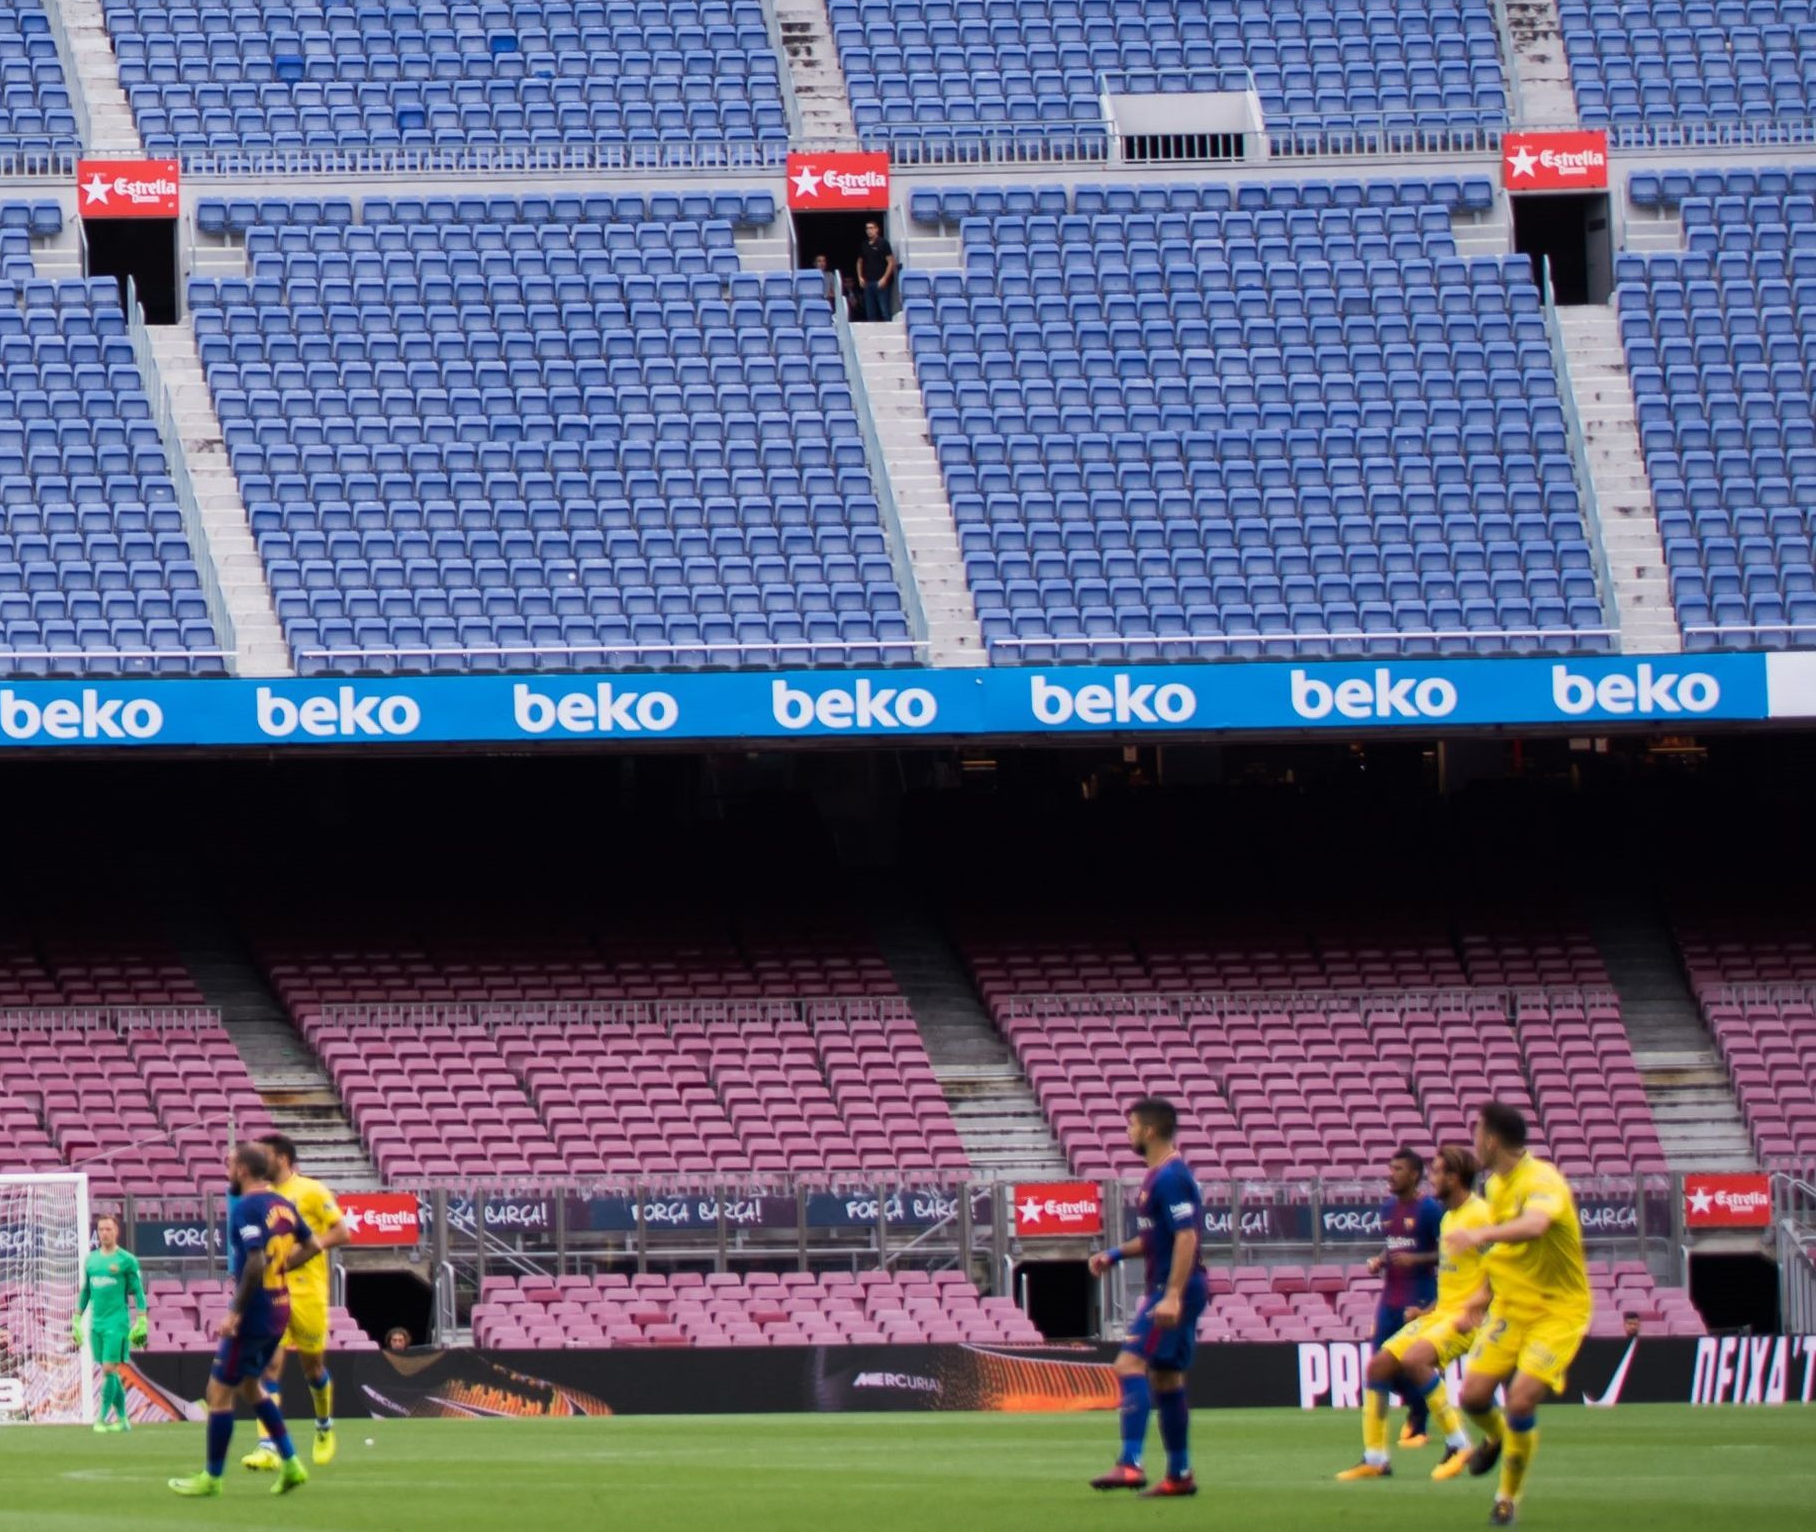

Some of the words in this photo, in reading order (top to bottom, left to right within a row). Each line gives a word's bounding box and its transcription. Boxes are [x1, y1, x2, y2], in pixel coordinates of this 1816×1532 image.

[1540, 149, 1604, 169] Estrella
[114, 177, 176, 196] Estrella
[823, 170, 887, 189] Estrella
[773, 679, 937, 728] beko
[1031, 674, 1196, 724] beko
[1291, 669, 1457, 718] beko
[1553, 664, 1719, 713] beko
[0, 689, 162, 738] beko
[257, 687, 420, 736] beko
[514, 683, 678, 732] beko
[364, 1209, 416, 1225] Estrella
[485, 1202, 549, 1226] BARÇA!
[1044, 1199, 1097, 1215] Estrella
[1323, 1211, 1382, 1233] FORÇA
